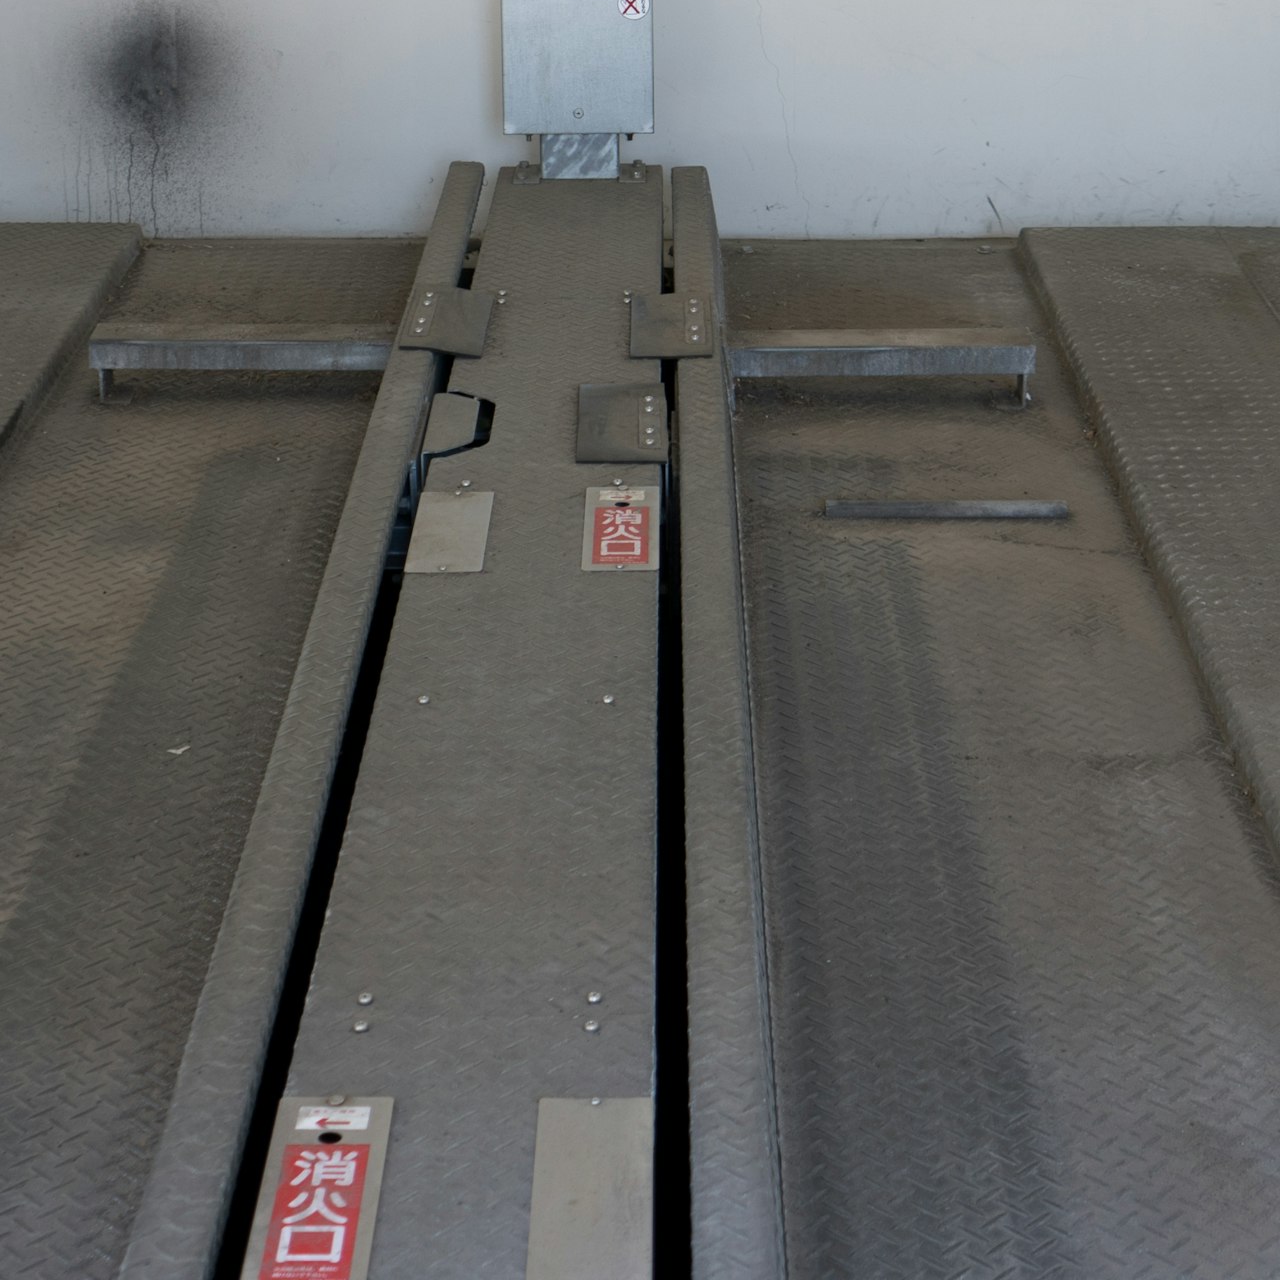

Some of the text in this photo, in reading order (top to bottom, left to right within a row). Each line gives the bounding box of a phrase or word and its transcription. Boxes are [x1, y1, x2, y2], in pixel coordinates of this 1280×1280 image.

[601, 509, 642, 556] 消火口
[275, 1150, 358, 1263] 消火口
